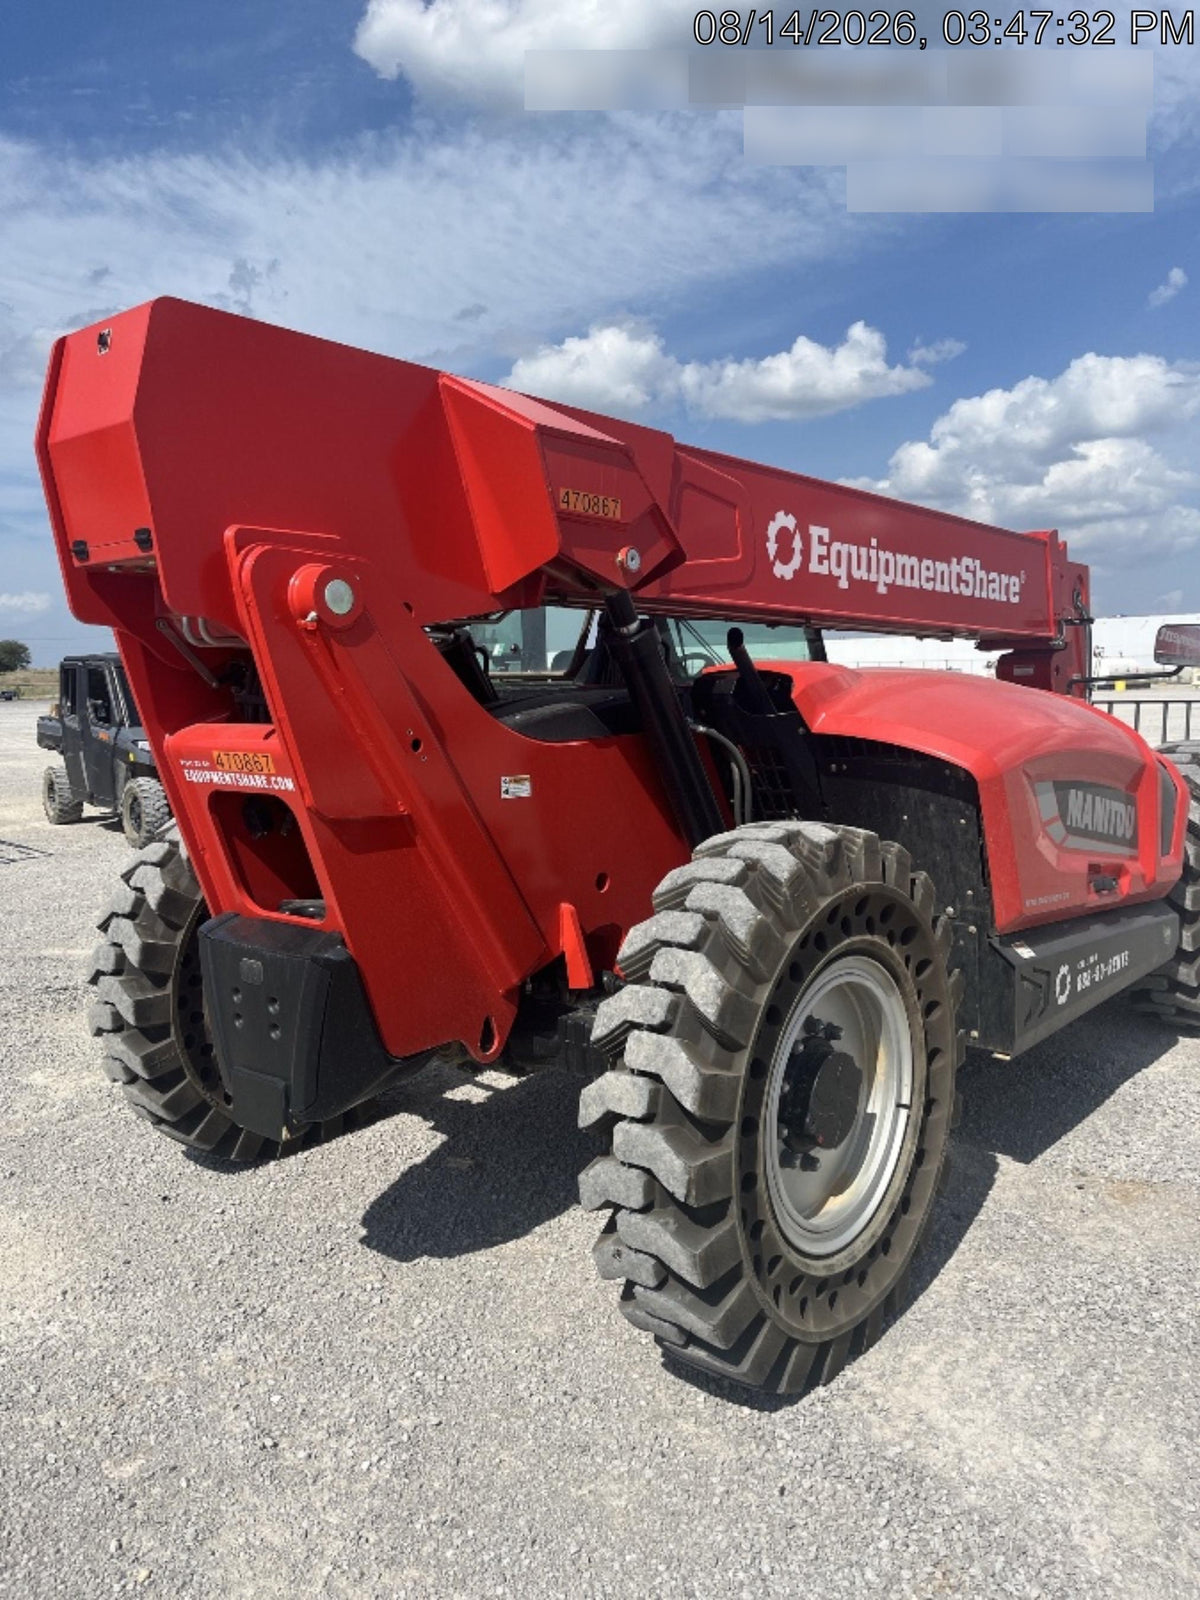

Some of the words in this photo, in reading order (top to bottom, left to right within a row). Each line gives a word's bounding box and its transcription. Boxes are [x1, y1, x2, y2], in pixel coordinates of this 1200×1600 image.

[561, 489, 619, 517] 470867
[216, 753, 272, 772] 470867
[184, 769, 296, 791] EQUIPMENTSHARE.COM
[1067, 789, 1135, 839] MANITOU
